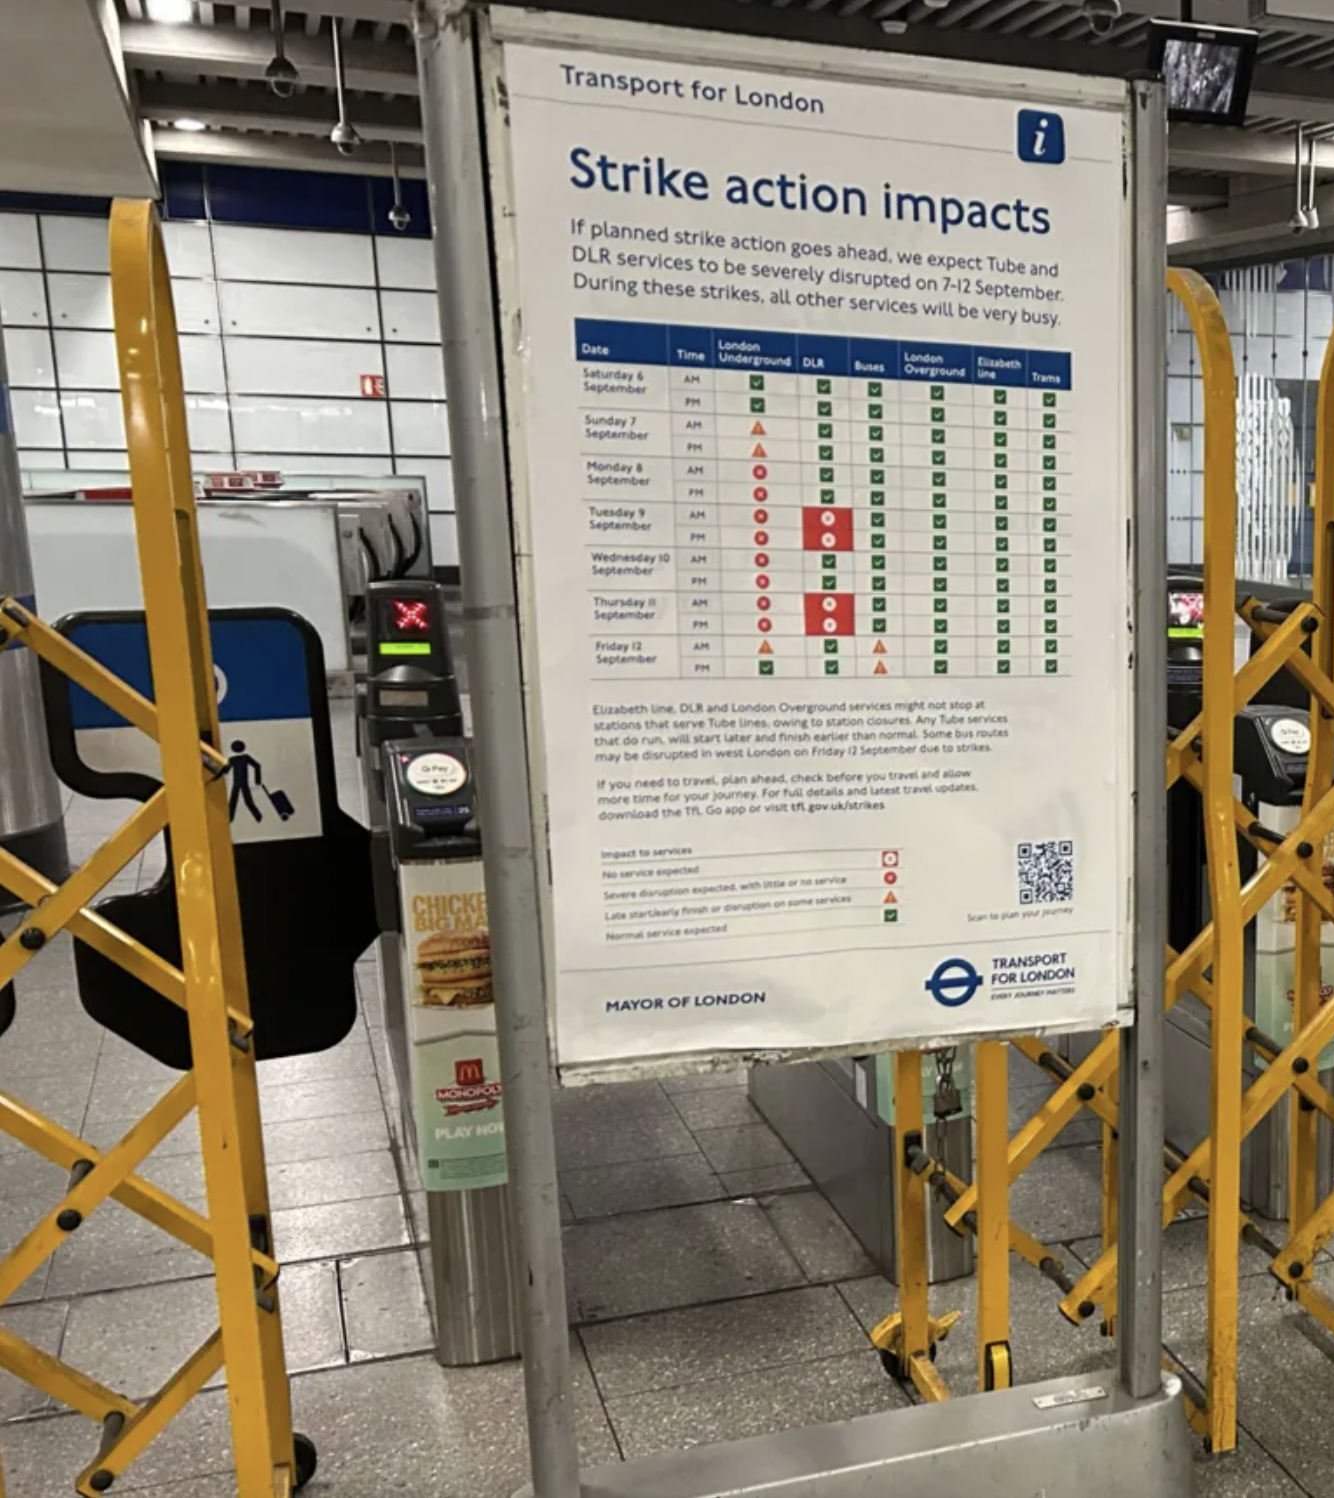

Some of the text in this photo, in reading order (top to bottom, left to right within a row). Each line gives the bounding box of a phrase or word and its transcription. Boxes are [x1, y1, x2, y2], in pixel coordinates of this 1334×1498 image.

[559, 63, 824, 114] Transport for London
[570, 147, 1050, 234] Strike action impacts
[571, 218, 585, 235] If
[590, 220, 668, 243] planned
[674, 230, 725, 248] strike
[730, 236, 786, 253] action
[790, 241, 832, 259] goes
[896, 251, 922, 265] we
[926, 254, 982, 271] expect
[986, 255, 1026, 274] Tube
[1029, 263, 1059, 278] and
[572, 244, 1063, 302] DLR services to be severely disrupted on 7-12 September.
[573, 271, 1060, 329] During these strikes, all other services will be very busy.
[581, 343, 609, 355] Date
[718, 339, 760, 351] London
[677, 348, 705, 361] Time
[718, 351, 792, 367] Underground
[904, 351, 943, 363] London
[802, 357, 824, 368] DLR
[854, 360, 885, 372] Buses
[977, 356, 1022, 369] Elizabeth
[582, 367, 633, 382] Saturday
[904, 363, 966, 377] Overground
[977, 369, 996, 379] line
[1031, 371, 1060, 383] Trams
[583, 380, 647, 394] September
[584, 414, 636, 428] Sunday 7
[585, 427, 648, 441] September
[586, 461, 633, 474] Monday
[587, 474, 650, 486] September
[588, 505, 635, 519] Tuesday
[589, 519, 652, 531] September
[591, 552, 656, 564] Wednesday
[591, 564, 654, 577] September
[593, 596, 645, 609] Thursday
[593, 609, 655, 621] September
[595, 641, 629, 653] Friday
[595, 653, 657, 665] September
[592, 704, 648, 716] Elizabeth
[679, 702, 703, 714] DLR
[706, 703, 728, 713] and
[731, 702, 776, 713] London
[778, 701, 846, 714] Overground
[848, 702, 892, 712] services
[894, 700, 925, 712] might
[927, 701, 946, 710] not
[949, 700, 973, 711] stop
[974, 700, 985, 709] at
[593, 721, 642, 731] stations
[644, 719, 669, 729] that
[672, 720, 705, 730] serve
[707, 717, 736, 728] Tube
[772, 718, 809, 730] owing
[810, 717, 823, 727] to
[825, 717, 864, 727] station
[915, 714, 936, 727] Any
[938, 713, 965, 725] Tube
[967, 715, 1008, 724] services
[596, 779, 606, 789] If
[609, 781, 631, 791] you
[634, 777, 664, 788] need
[666, 777, 680, 787] to
[721, 774, 748, 787] plan
[790, 772, 823, 783] check
[826, 772, 863, 782] before
[866, 773, 886, 783] you
[888, 770, 919, 780] travel
[920, 769, 940, 779] and
[942, 769, 971, 779] allow
[597, 795, 630, 805] more
[632, 794, 661, 803] time
[662, 792, 680, 802] for
[683, 792, 709, 803] your
[761, 787, 780, 798] For
[782, 787, 803, 798] full
[806, 786, 844, 798] details
[846, 786, 867, 796] and
[869, 786, 900, 796] latest
[902, 783, 933, 794] travel
[598, 808, 659, 821] download
[661, 808, 682, 818] the
[705, 804, 722, 815] Go
[724, 805, 746, 816] app
[748, 805, 761, 813] or
[764, 803, 788, 812] visit
[412, 891, 486, 915] CHICKE
[454, 912, 487, 931] MA
[992, 952, 1067, 969] TRANSPORT
[991, 967, 1075, 985] FOR LONDON
[605, 992, 765, 1012] MAYOR OF LONDON
[434, 1125, 472, 1140] PLAY
